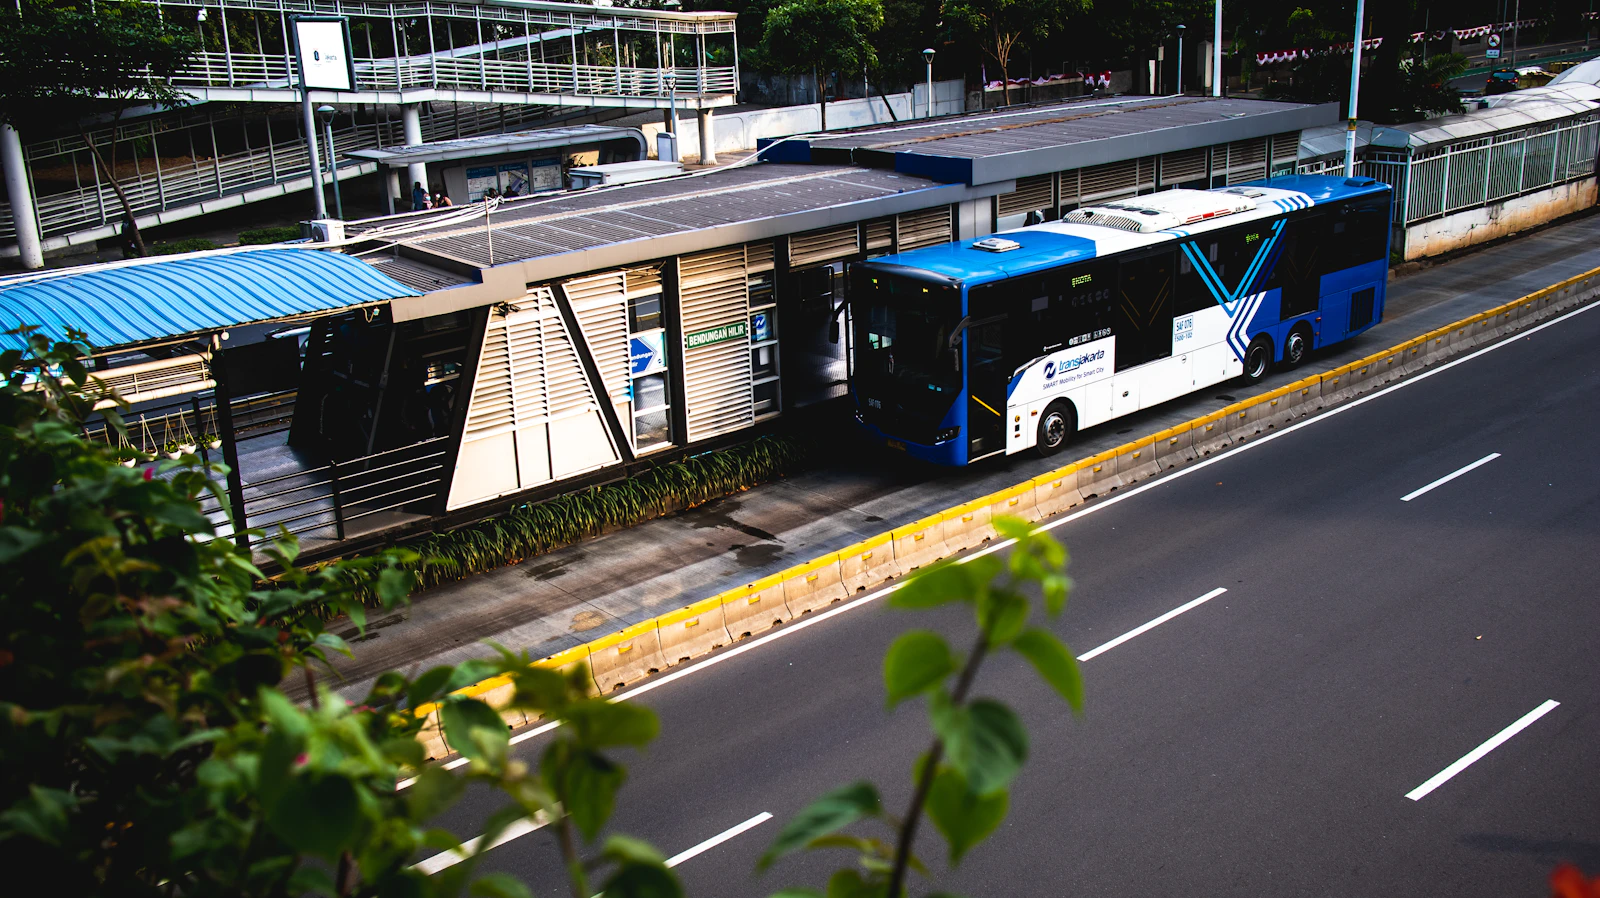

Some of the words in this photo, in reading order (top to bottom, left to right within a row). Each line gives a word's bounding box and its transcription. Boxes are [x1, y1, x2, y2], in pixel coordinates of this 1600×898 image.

[688, 327, 728, 347] BENDUNGAN
[728, 324, 745, 338] HILIR
[1058, 349, 1105, 373] transjakarta
[1042, 380, 1059, 391] SMART
[1059, 374, 1076, 386] Mobility
[1083, 369, 1096, 378] Smart
[1096, 367, 1104, 375] City
